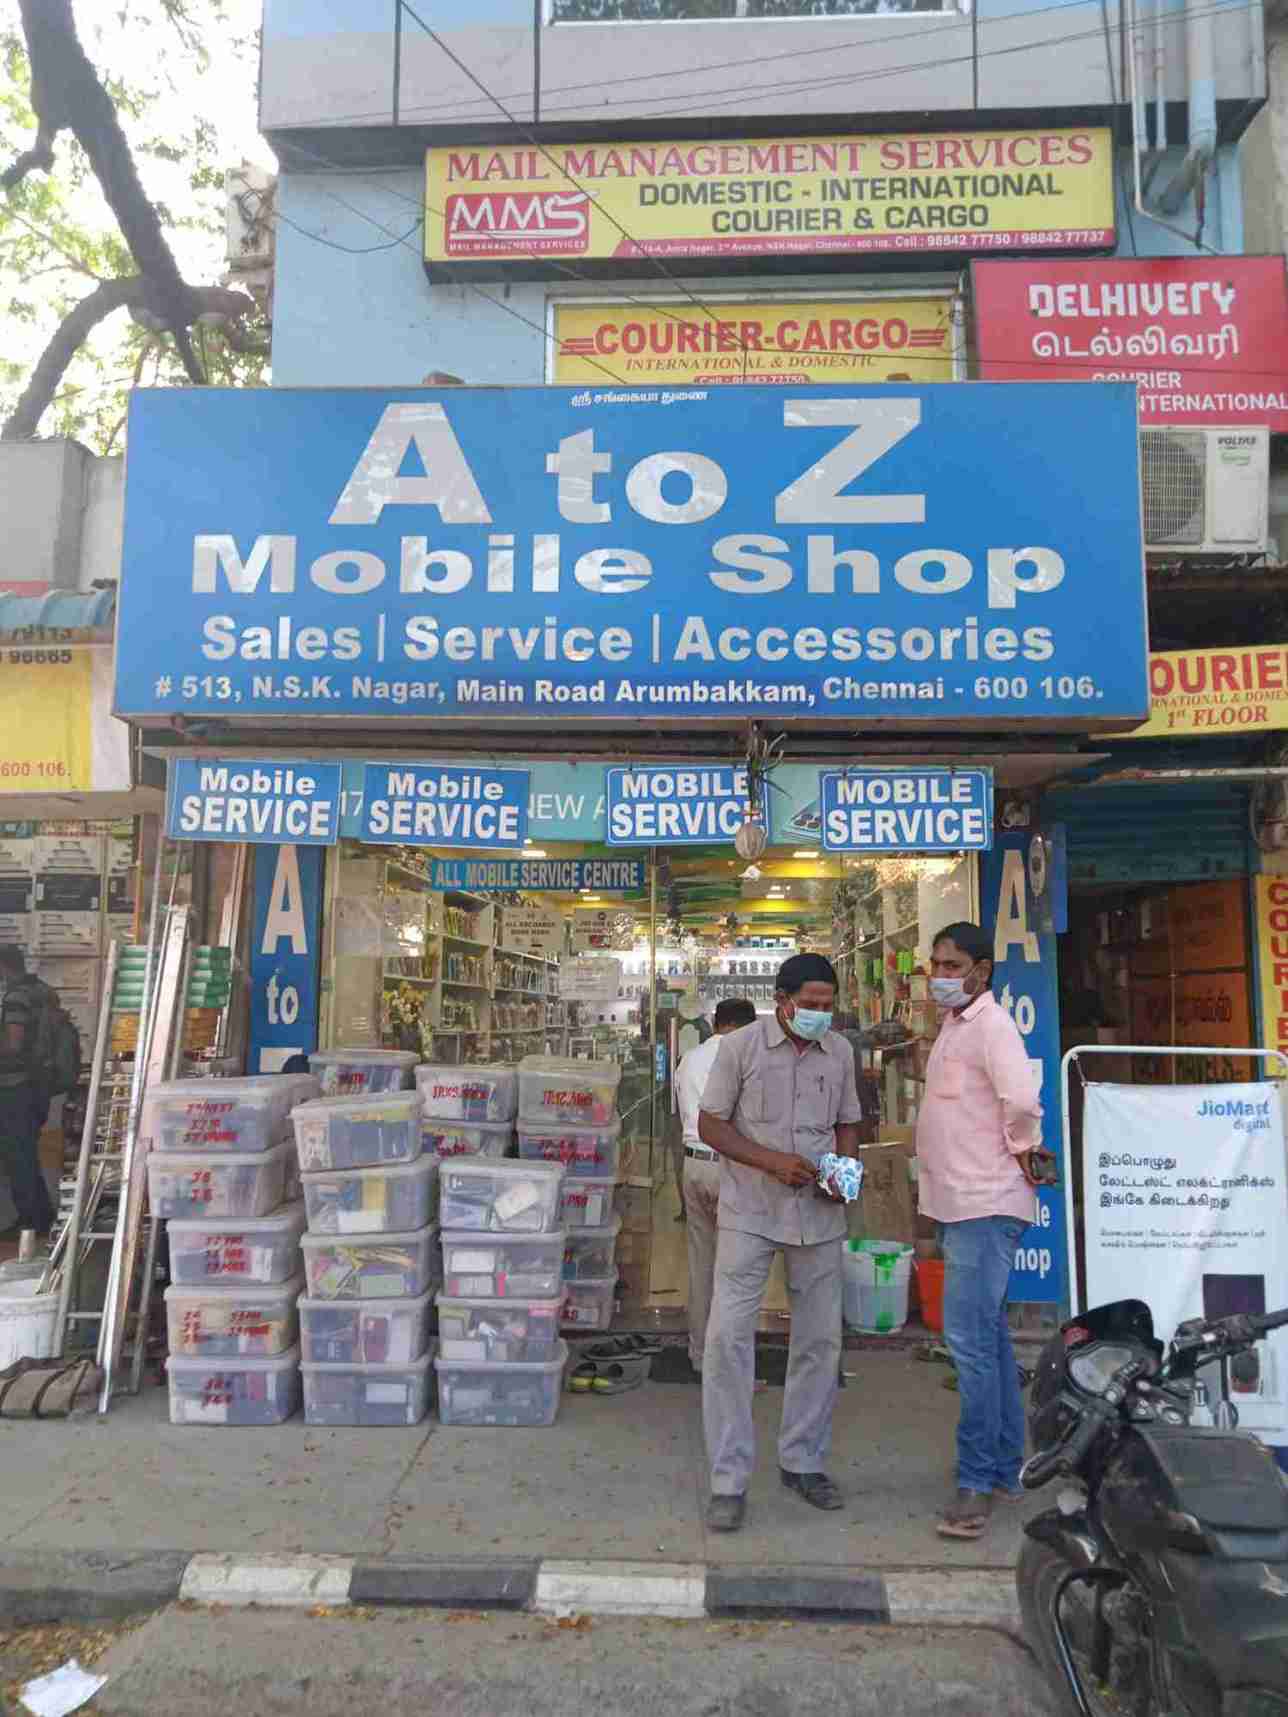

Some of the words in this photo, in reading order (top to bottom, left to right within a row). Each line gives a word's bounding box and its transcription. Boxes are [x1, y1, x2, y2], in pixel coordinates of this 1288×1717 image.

[446, 150, 548, 182] MAIL
[562, 142, 867, 179] MANAGEMENT
[879, 134, 1093, 171] SERVICES
[639, 180, 793, 206] DOMESTIC
[821, 172, 1063, 201] INTERNATIONAL
[449, 190, 598, 238] MMS
[711, 208, 842, 234] COURIER
[853, 206, 874, 231] &
[885, 203, 989, 230] CARGO
[1028, 281, 1236, 317] DELHIVERY
[595, 318, 909, 355] COURIER-CARGO
[1031, 323, 1240, 361] டெல்லிவரி
[625, 356, 765, 372] INTERNATIONAL
[770, 354, 784, 369] &
[787, 352, 877, 369] DOMESTIC
[1140, 393, 1288, 412] TERNATIONAL
[328, 402, 493, 524] A
[545, 428, 727, 524] to
[774, 397, 926, 523] Z
[192, 533, 653, 593] Mobile
[709, 533, 1065, 609] Shop
[201, 615, 362, 662] Sales
[403, 614, 633, 662] Service
[673, 614, 1055, 662] Accessories
[155, 675, 173, 699] #
[181, 676, 242, 702] 513,
[251, 676, 342, 699] N.S.K.
[352, 677, 446, 704] Nagar,
[456, 679, 524, 702] Main
[534, 679, 605, 702] Road
[616, 679, 816, 705] Arumbakkam,
[823, 676, 944, 700] Chennai
[973, 677, 1029, 700] 600
[1040, 677, 1104, 700] 106.
[1150, 652, 1288, 697] OURIE
[1192, 705, 1268, 727] FLOOR
[0, 762, 30, 777] 600
[200, 766, 316, 796] Mobile
[387, 771, 505, 801] Mobile
[622, 769, 750, 799] MOBILE
[836, 777, 973, 806] MOBILE
[179, 796, 332, 837] SERVICE
[368, 800, 521, 841] SERVICE
[826, 807, 984, 844] SERVICE
[435, 862, 461, 887] ALL
[468, 862, 518, 889] MOBILE
[521, 862, 580, 889] SERVICE
[584, 861, 640, 889] CENTRE
[261, 845, 308, 954] A
[994, 849, 1041, 963] A
[266, 973, 300, 1025] to
[1098, 1152, 1177, 1170] இப்பொழுது
[1099, 1191, 1145, 1208] இங்கே
[1148, 1192, 1231, 1210] கிடைக்கிறது
